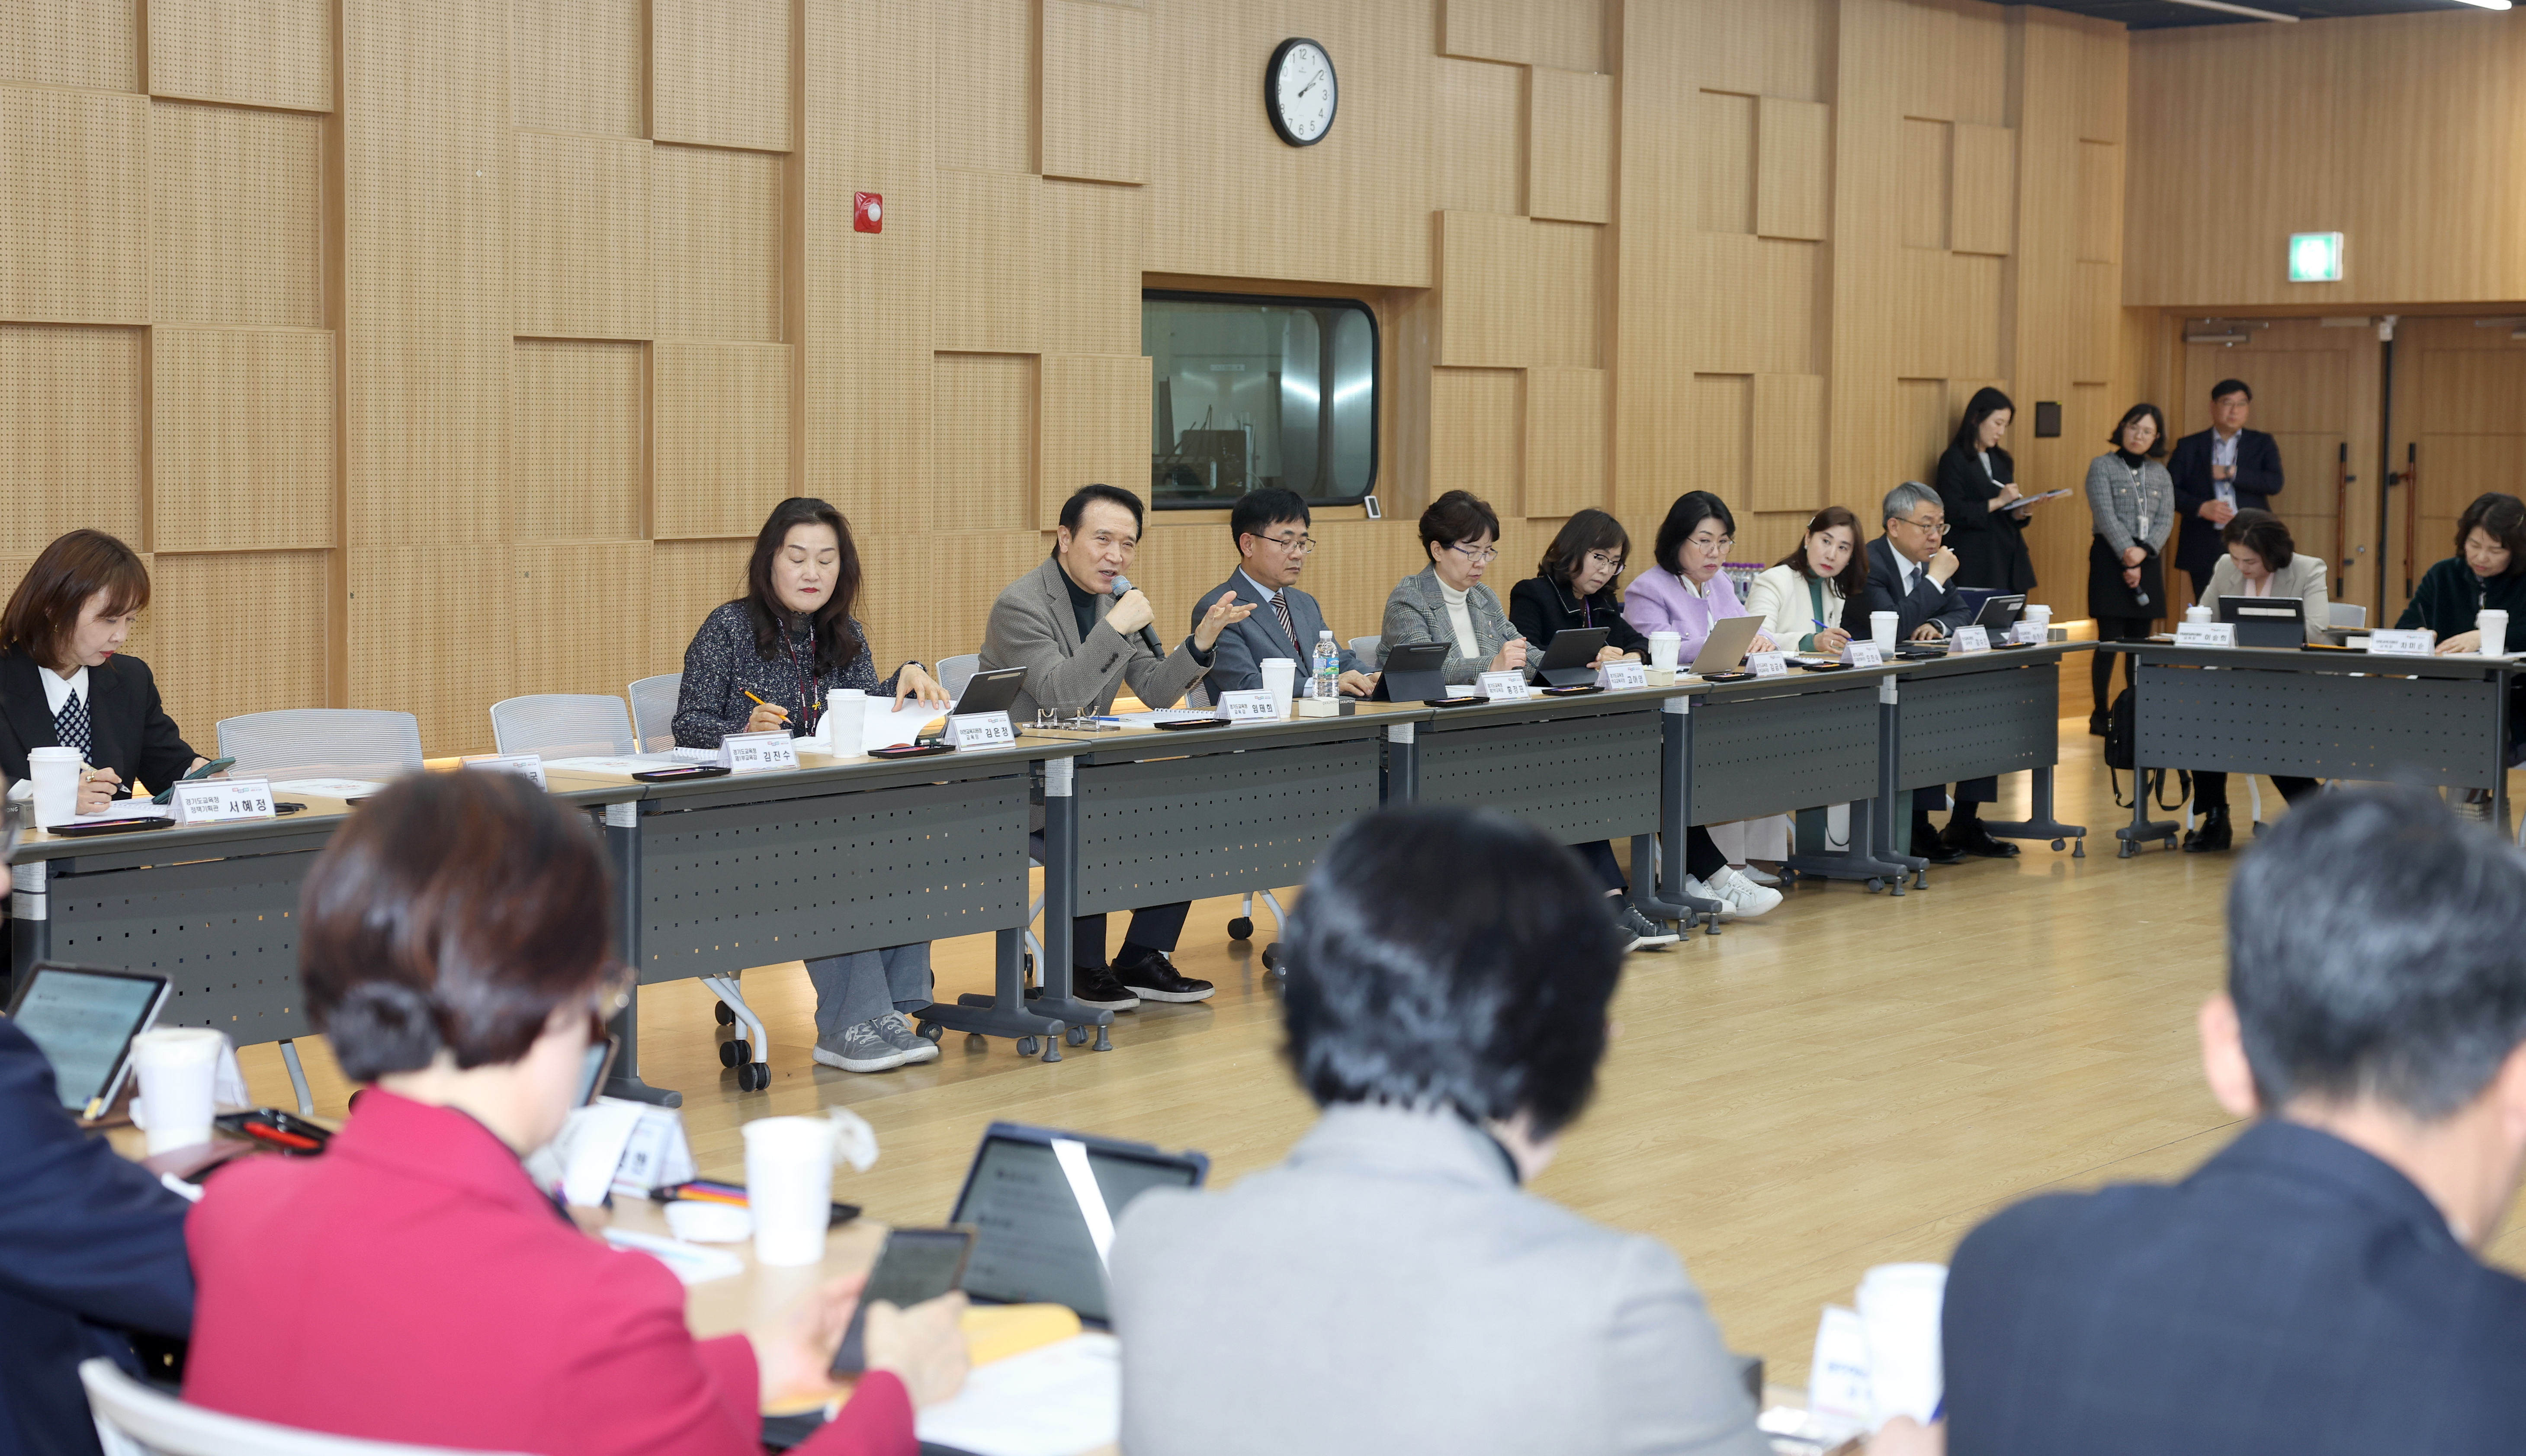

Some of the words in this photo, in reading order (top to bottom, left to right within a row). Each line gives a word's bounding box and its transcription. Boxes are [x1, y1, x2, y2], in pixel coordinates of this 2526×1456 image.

[1299, 48, 1307, 60] 12
[1313, 55, 1315, 65] 1
[1319, 70, 1324, 80] 2
[1323, 90, 1328, 100] 3
[1280, 103, 1285, 115] 8
[1319, 108, 1323, 118] 4
[1288, 118, 1293, 130] 7
[1310, 121, 1315, 131] 5
[1299, 124, 1304, 135] 6
[1770, 663, 1784, 671] 김금숙
[1627, 675, 1643, 683] 고아영
[1507, 685, 1525, 694] 홍정표
[1252, 704, 1273, 713] 임태희
[985, 727, 1008, 738] 김은정
[764, 750, 790, 762] 김진수
[186, 796, 219, 805] 경기도교육청
[190, 805, 219, 814] 정책기획관
[230, 799, 266, 813] 서혜정
